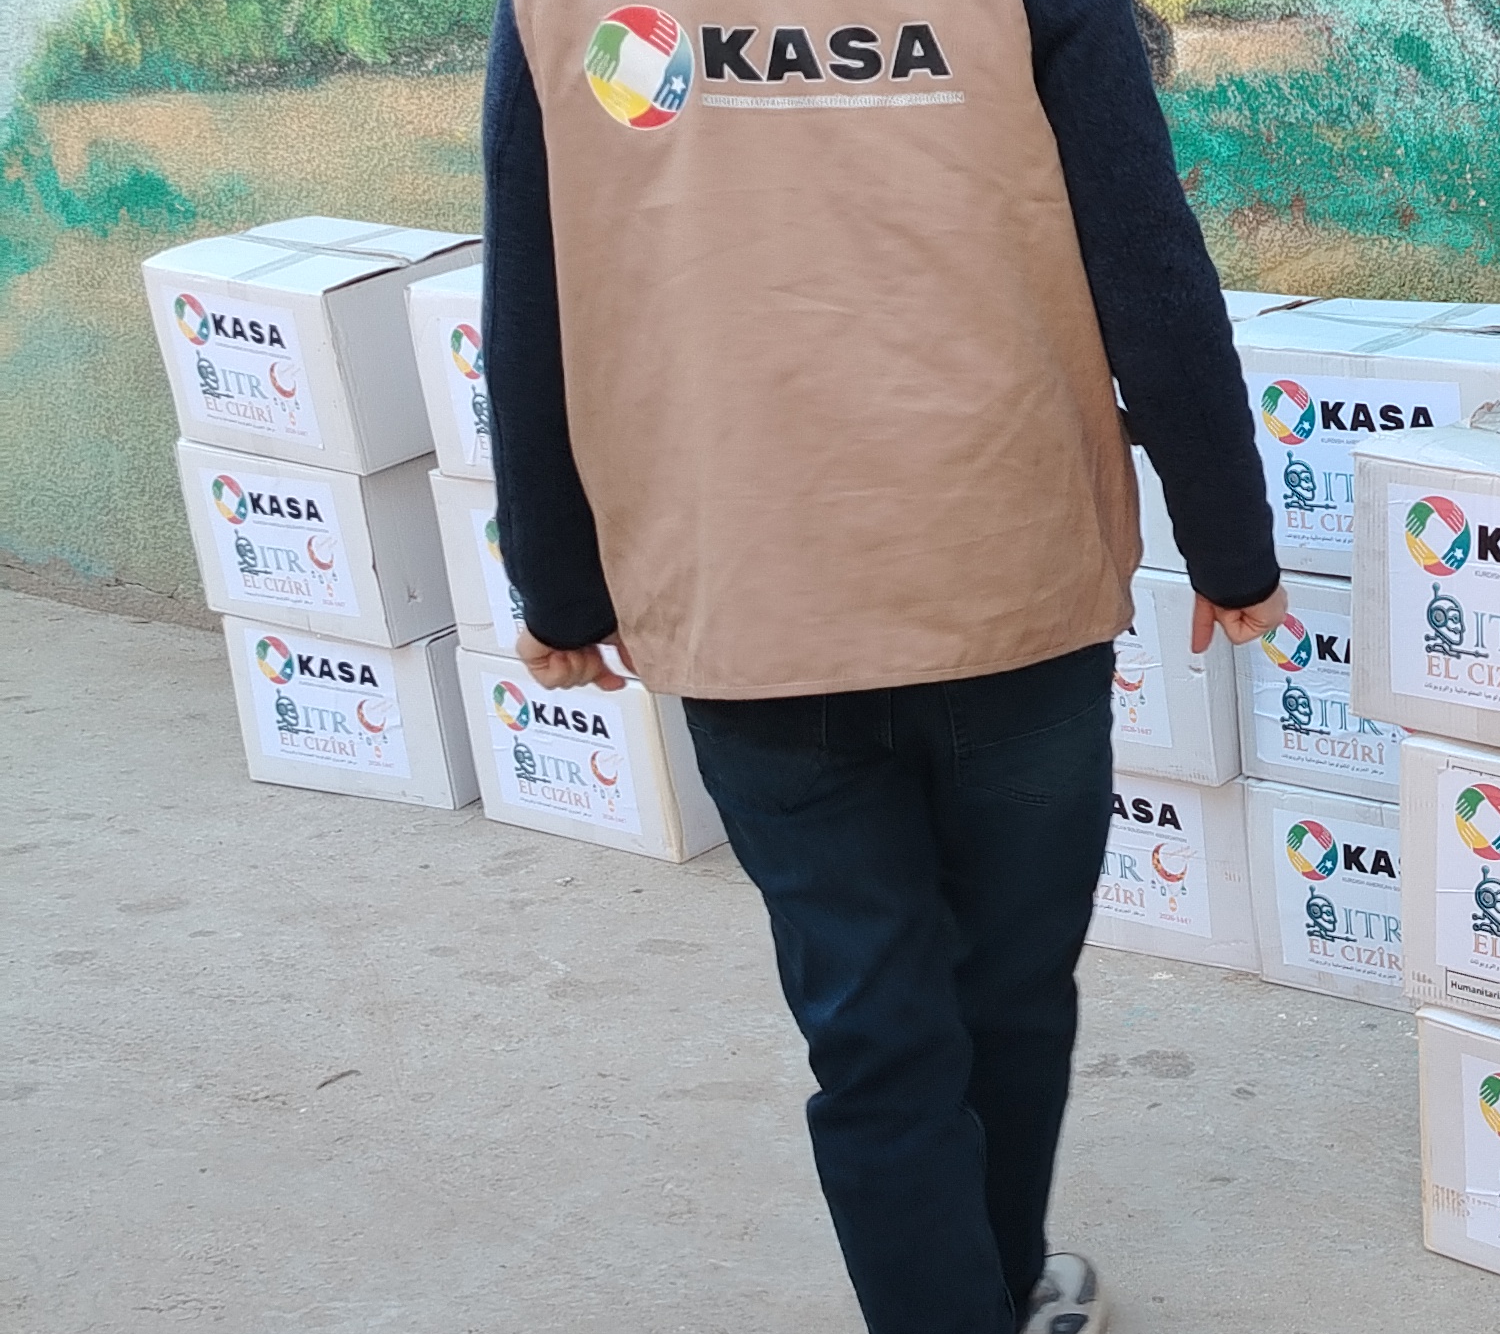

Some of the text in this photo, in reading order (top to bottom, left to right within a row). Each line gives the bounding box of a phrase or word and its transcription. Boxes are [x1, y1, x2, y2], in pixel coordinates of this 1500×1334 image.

[700, 24, 952, 82] KASA
[210, 312, 287, 350] KASA
[221, 368, 269, 400] ITR
[204, 396, 224, 413] EL
[1320, 400, 1435, 433] KASA
[1322, 471, 1354, 503] IT
[248, 491, 325, 523] KASA
[1286, 510, 1314, 530] EL
[258, 545, 307, 574] ITR
[243, 574, 262, 589] EL
[297, 653, 379, 687] KASA
[1426, 653, 1459, 681] EL
[302, 705, 353, 734] ITR
[531, 700, 611, 740] KASA
[280, 732, 299, 748] EL
[1283, 731, 1309, 752] EL
[1315, 736, 1385, 765] CIZÎRÎ
[538, 753, 588, 787] ITR
[518, 780, 538, 797] EL
[1112, 792, 1183, 832] ASA
[1101, 850, 1144, 882] TR
[1343, 843, 1401, 879] KA
[1309, 937, 1335, 958] EL
[1341, 946, 1403, 972] CIZÎR
